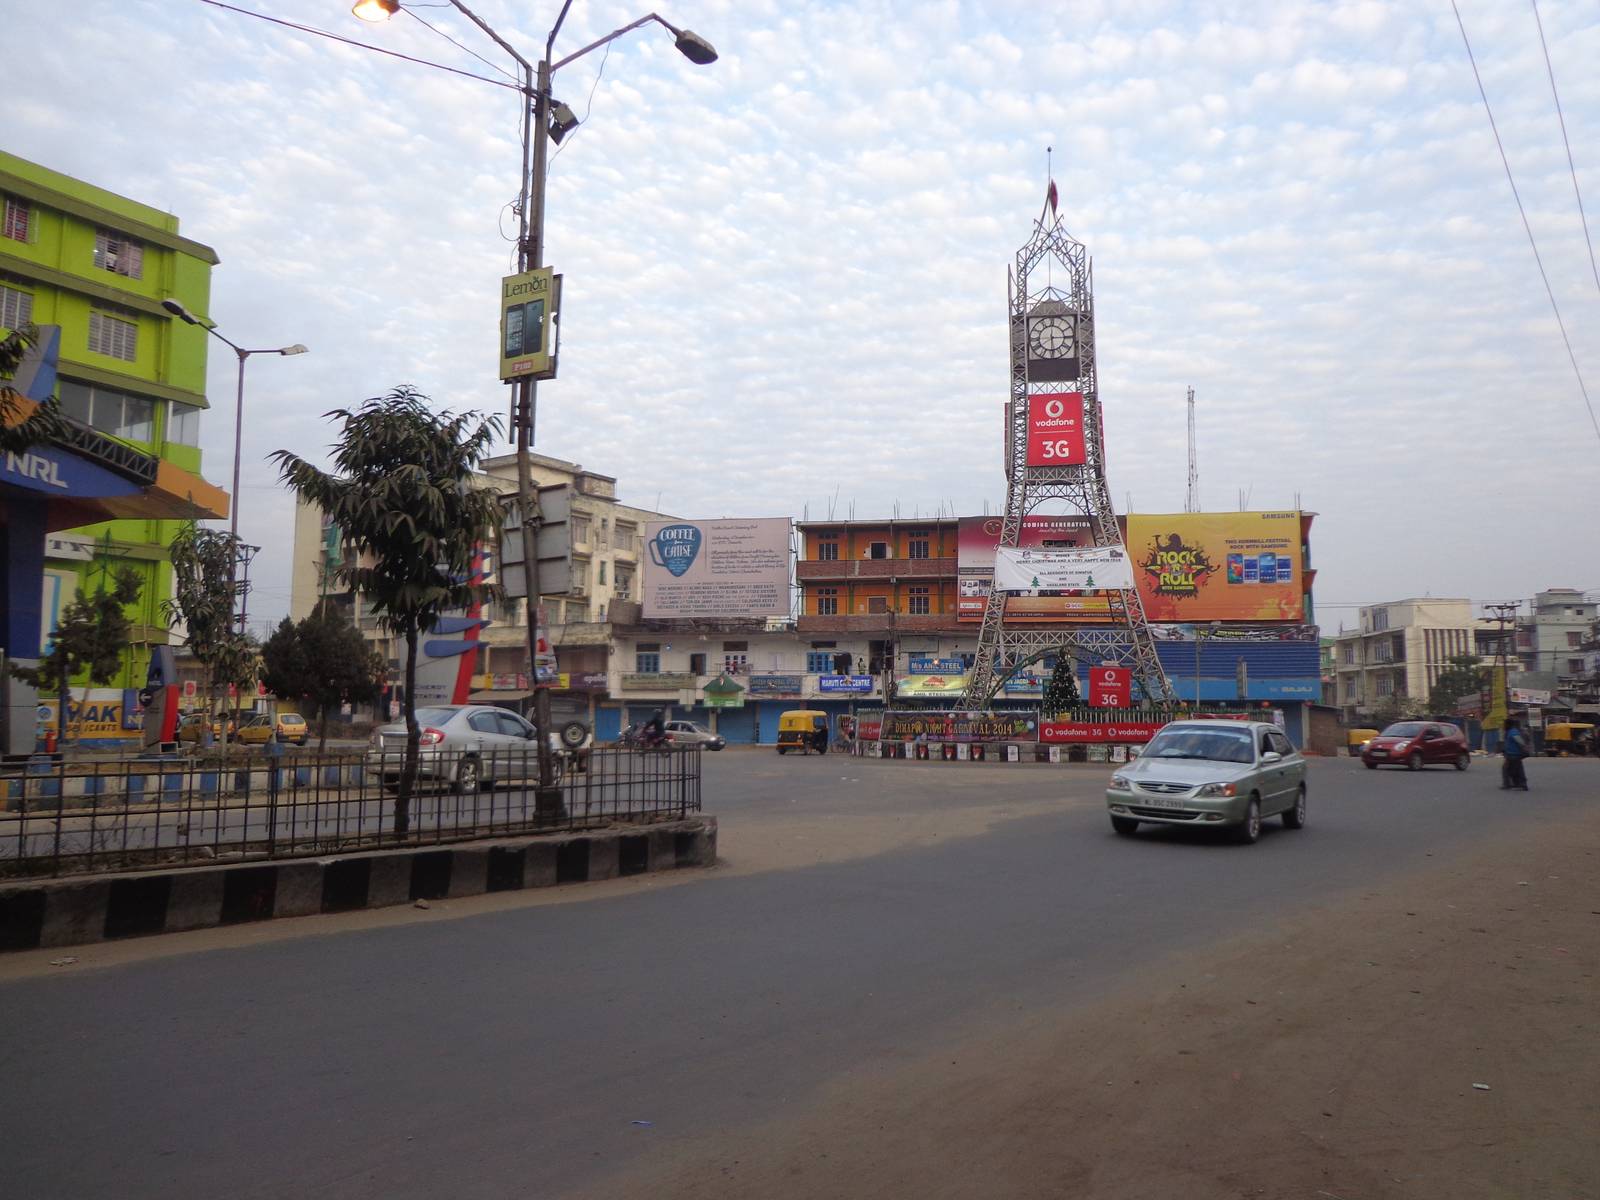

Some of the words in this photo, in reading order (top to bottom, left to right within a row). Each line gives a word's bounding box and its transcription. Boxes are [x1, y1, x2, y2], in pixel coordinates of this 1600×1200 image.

[1035, 418, 1075, 427] vodafone
[1042, 440, 1069, 458] 3G
[7, 450, 69, 489] NRL
[660, 528, 696, 541] COFFEE
[664, 545, 693, 558] CAUSE
[1157, 551, 1197, 565] ROCK
[1160, 573, 1196, 585] ROLL
[852, 679, 871, 687] CENTRE
[1101, 694, 1118, 705] 3G
[992, 723, 1012, 734] 2014
[1055, 728, 1088, 736] vodafone
[1092, 728, 1102, 736] 3G
[1118, 728, 1148, 736] vodafone
